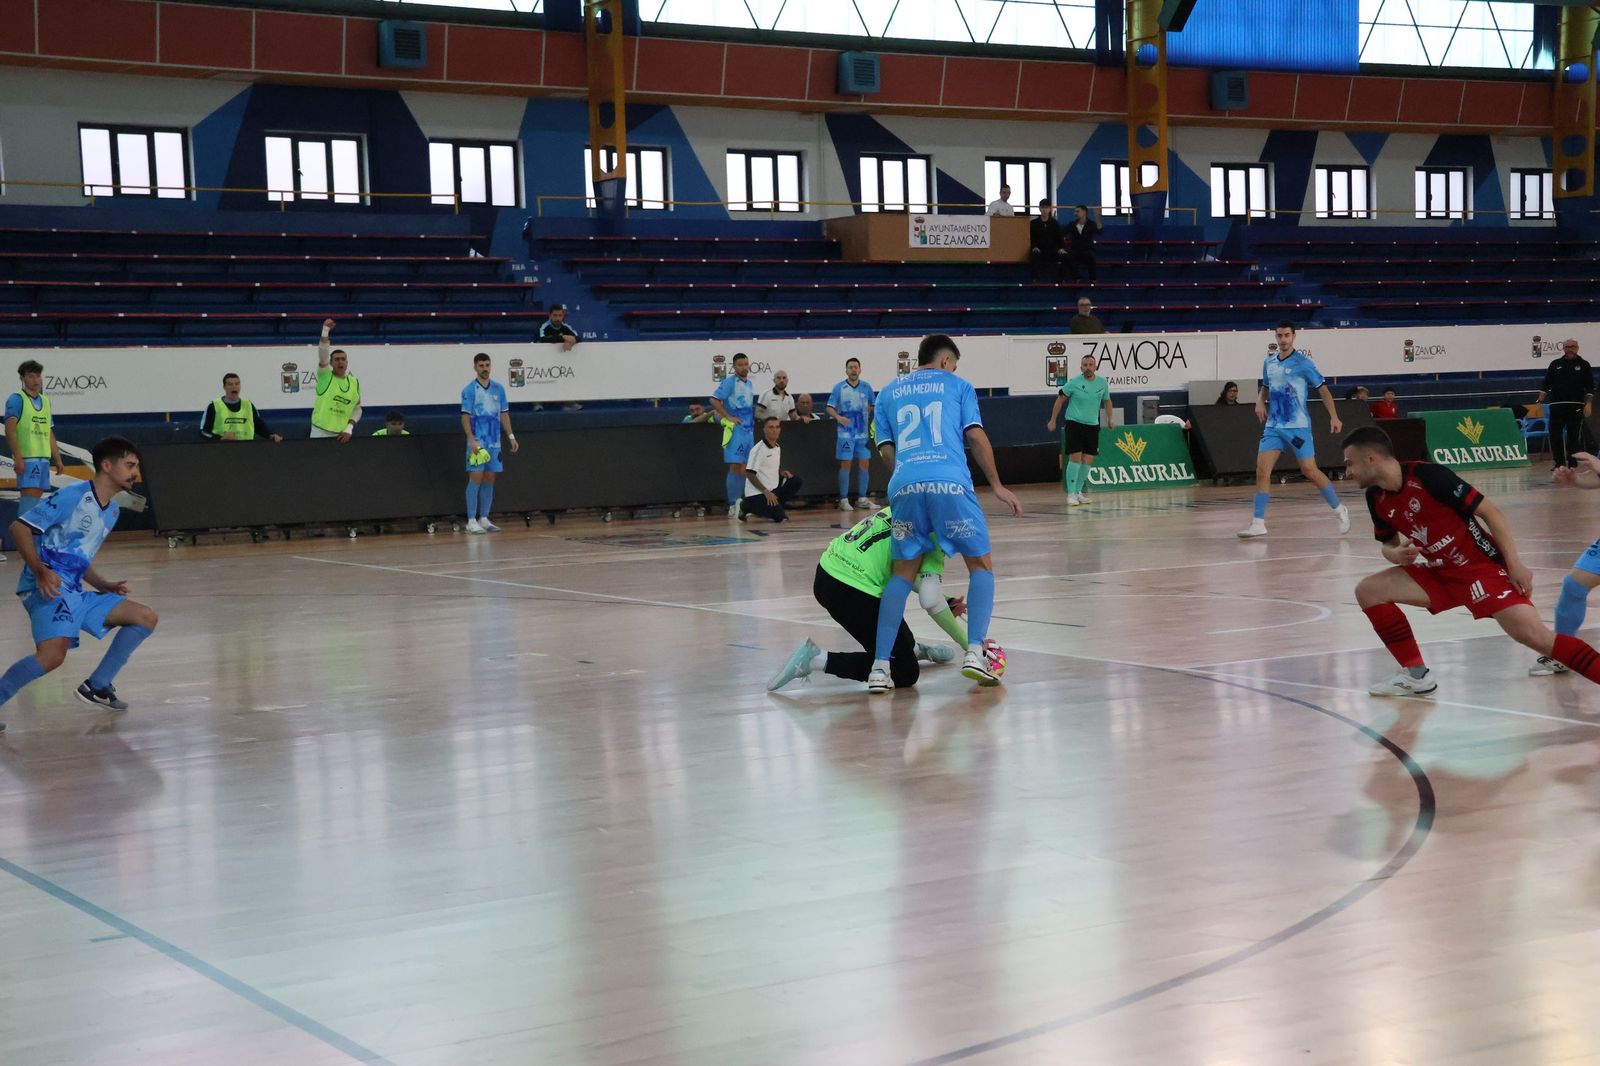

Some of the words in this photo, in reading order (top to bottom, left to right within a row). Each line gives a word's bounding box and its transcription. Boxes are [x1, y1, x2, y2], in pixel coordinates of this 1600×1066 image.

[929, 224, 988, 233] AYUNTAMIENTO
[929, 235, 941, 245] DE
[944, 235, 987, 246] ZAMORA
[1415, 345, 1447, 356] ZAMORA
[526, 366, 575, 379] ZAMORA
[45, 376, 107, 390] ZAMORA
[1106, 376, 1149, 385] TAMIENTO
[892, 384, 912, 400] ISMA
[912, 382, 945, 395] MEDINA
[897, 401, 944, 452] 21
[1433, 447, 1474, 465] CAJA
[1470, 445, 1528, 463] RURAL
[1087, 466, 1133, 485] CAJA
[1130, 463, 1195, 482] RURAL
